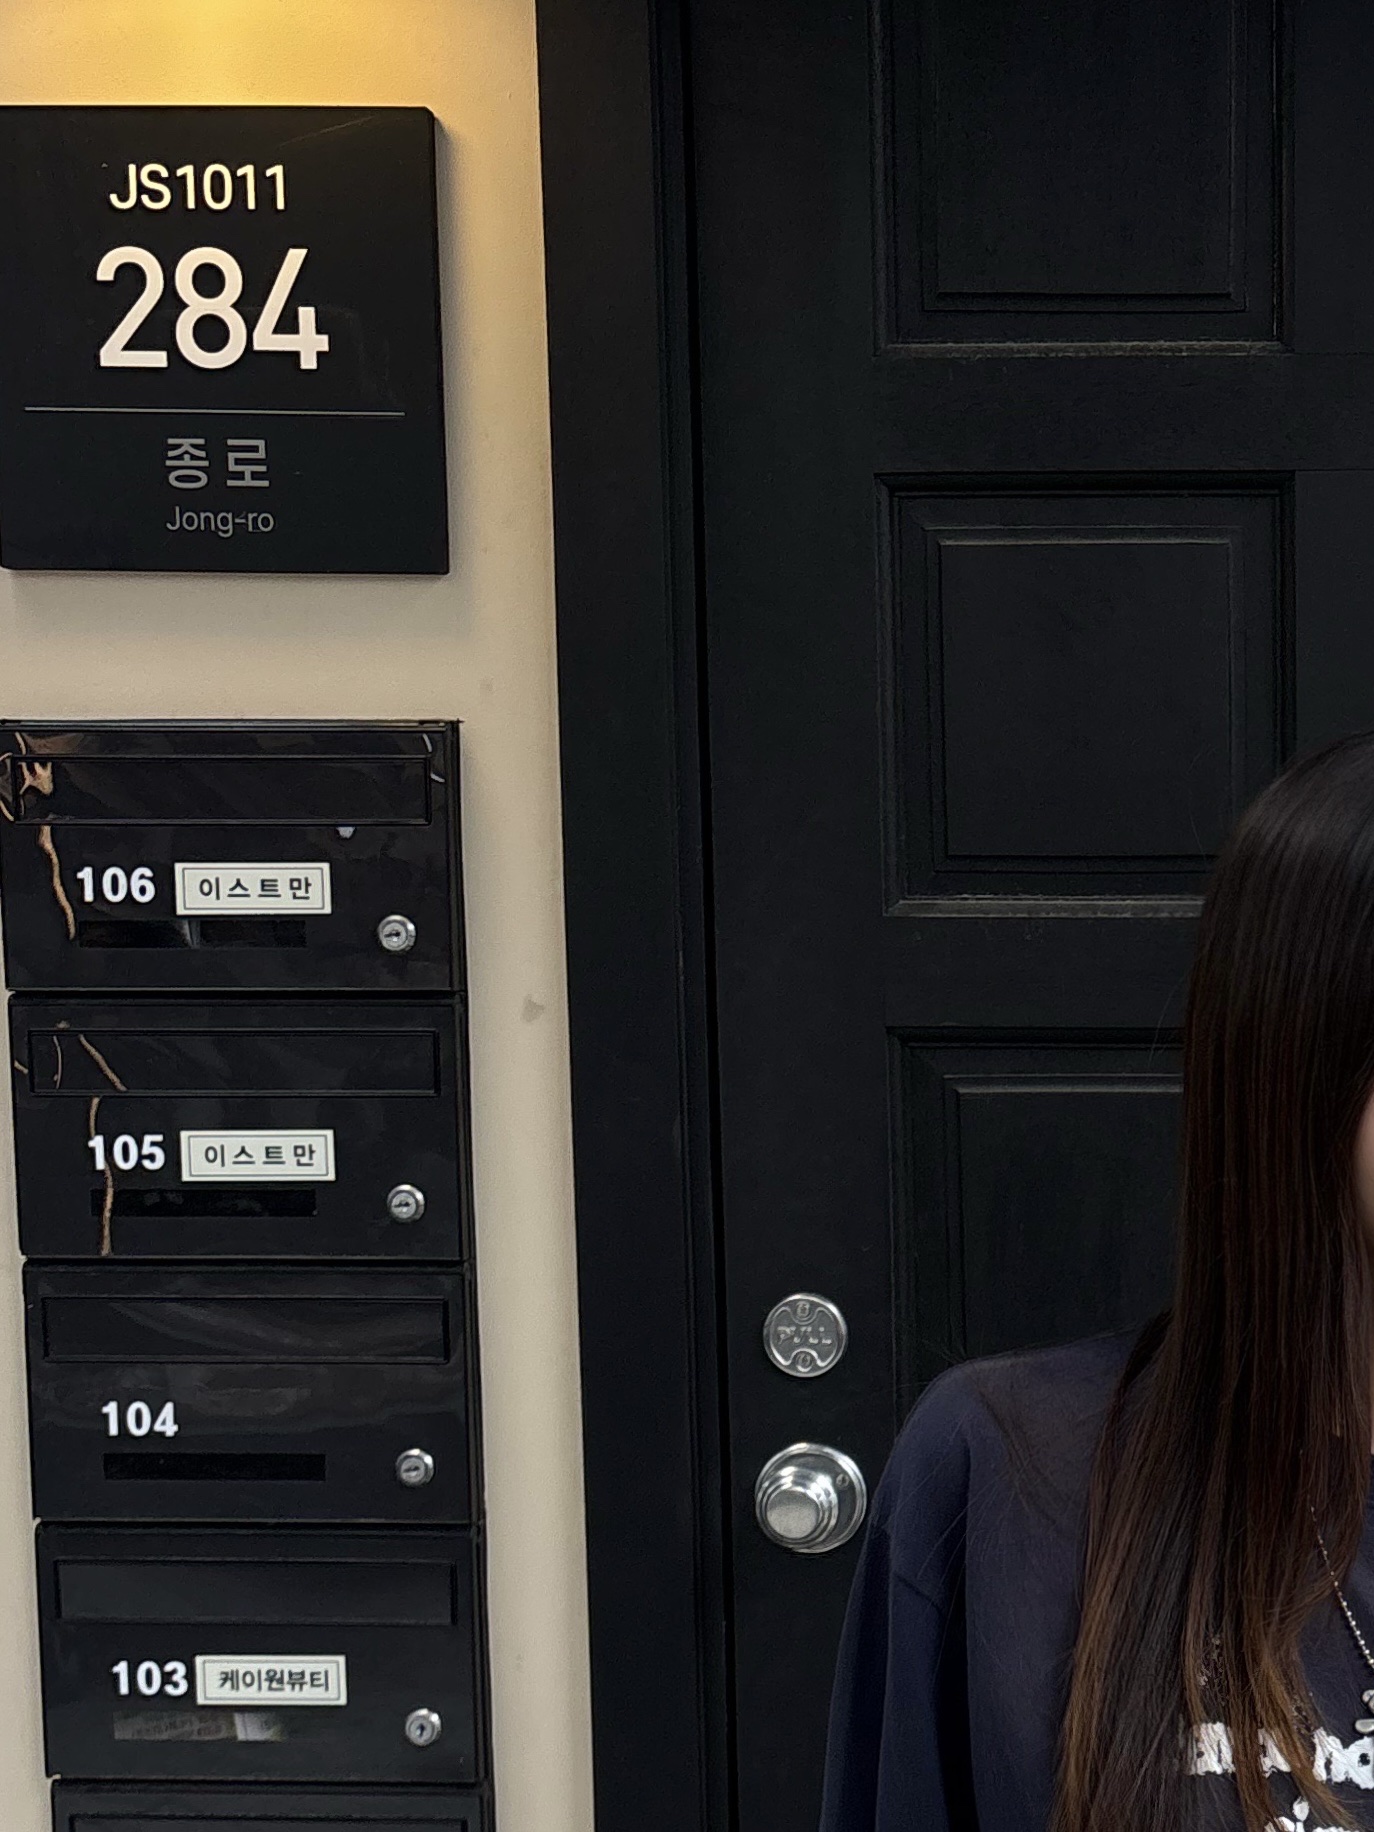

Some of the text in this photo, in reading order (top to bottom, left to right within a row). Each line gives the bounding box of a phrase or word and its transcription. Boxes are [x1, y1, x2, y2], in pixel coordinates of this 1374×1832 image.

[109, 163, 287, 210] JS1011
[96, 246, 330, 370] 284
[164, 437, 270, 489] 종로
[165, 506, 275, 538] Jong-ro
[76, 866, 313, 903] 106 이스트만
[87, 1134, 316, 1170] 105 이스트만
[101, 1400, 179, 1437] 104
[111, 1660, 330, 1696] 103 케이원뷰티
